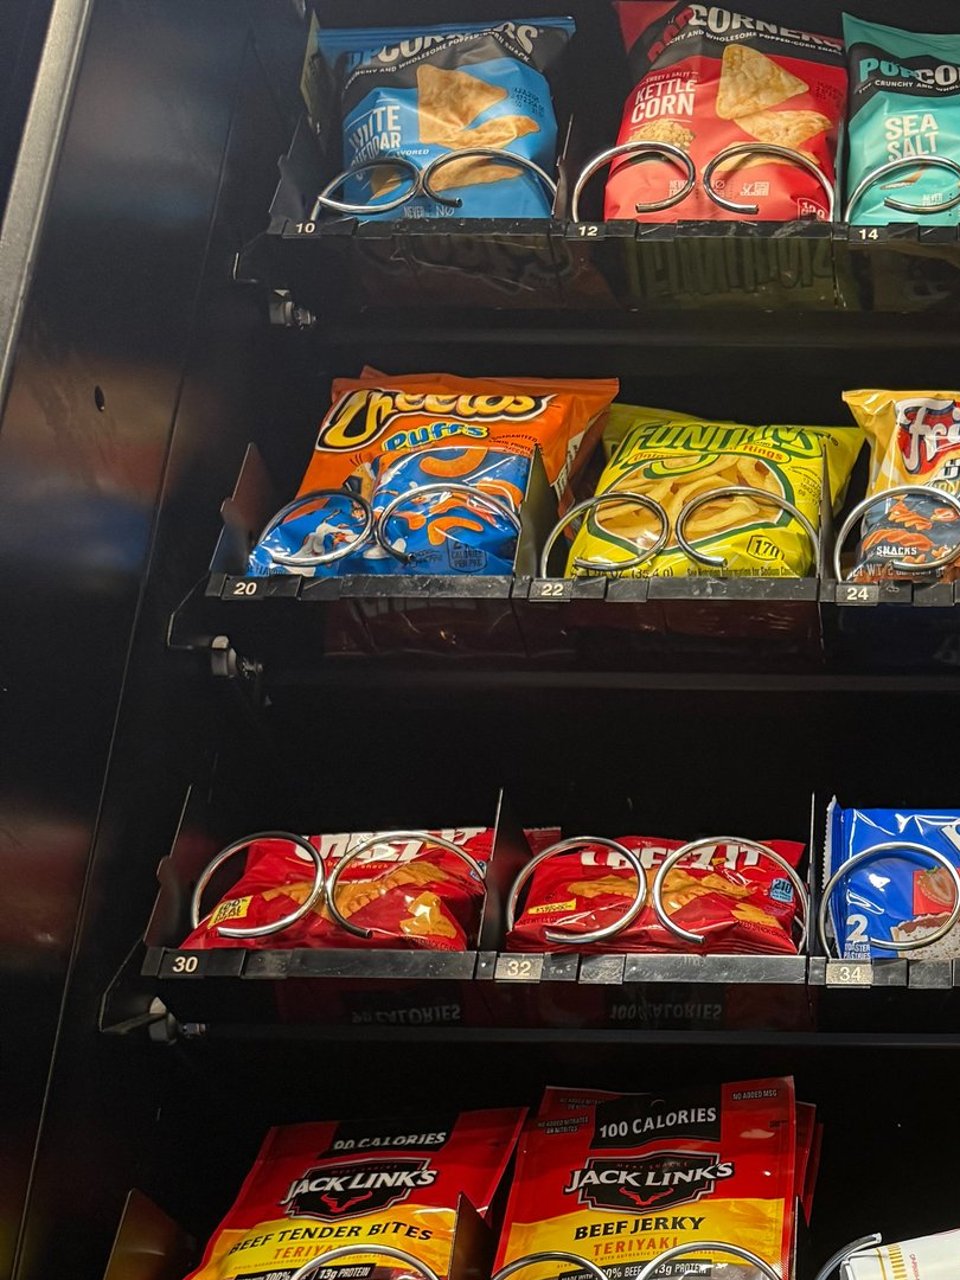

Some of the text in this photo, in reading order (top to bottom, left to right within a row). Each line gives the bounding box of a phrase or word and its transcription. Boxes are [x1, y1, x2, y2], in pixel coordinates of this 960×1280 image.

[634, 78, 698, 105] KETTLE
[875, 79, 914, 88] CRUNCHY
[631, 94, 695, 123] CORN
[884, 113, 939, 141] SEA
[886, 131, 940, 163] SALT
[295, 223, 316, 234] 10
[578, 227, 598, 237] 12
[859, 229, 879, 240] 14
[320, 389, 538, 449] Cheetos
[381, 422, 490, 451] Puffs
[876, 546, 918, 557] SNACKS
[233, 582, 257, 595] 20
[541, 584, 563, 597] 22
[847, 588, 869, 601] 24
[846, 914, 868, 942] 2
[172, 957, 199, 973] 30
[507, 960, 532, 976] 32
[839, 967, 862, 982] 34
[600, 1107, 717, 1138] 100 CALORIES
[358, 1132, 446, 1148] CALORIES
[280, 1167, 438, 1205] JACK LINK'S
[564, 1161, 735, 1193] JACK LINK'S
[574, 1216, 706, 1241] BEEF JERKY
[229, 1221, 433, 1255] BEEF TENDER BITES
[593, 1236, 680, 1257] TERIYAKI
[318, 1267, 338, 1280] 13g
[337, 1266, 370, 1278] PROTEIN
